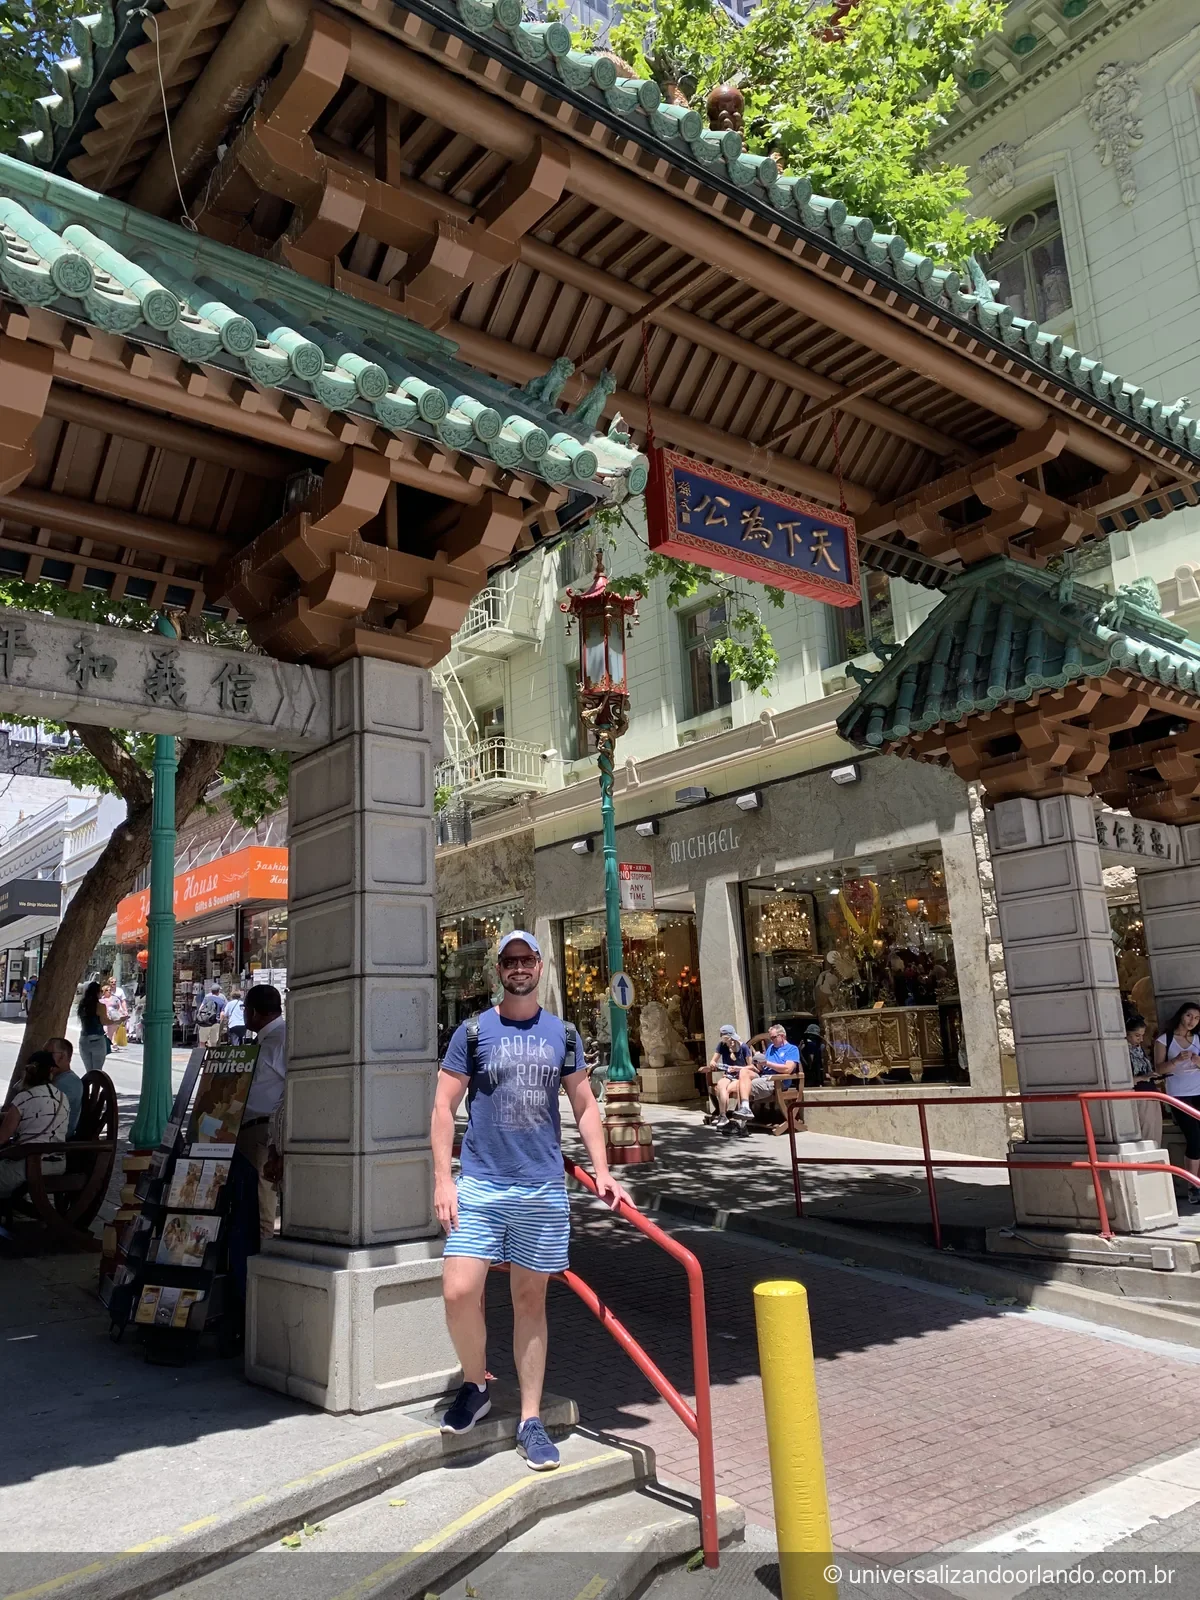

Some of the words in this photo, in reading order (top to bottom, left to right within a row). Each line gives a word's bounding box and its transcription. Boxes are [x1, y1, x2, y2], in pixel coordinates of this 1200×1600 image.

[254, 860, 288, 871] Fashio
[269, 874, 288, 884] Hou
[620, 871, 630, 880] NO
[183, 873, 219, 901] House
[630, 884, 644, 892] ANY
[213, 890, 241, 906] Souvenirs
[629, 892, 646, 900] TIME
[501, 1035, 548, 1060] ROCK
[209, 1049, 227, 1060] You
[228, 1048, 246, 1059] Are
[204, 1058, 255, 1074] Invited
[516, 1064, 559, 1088] ROAR
